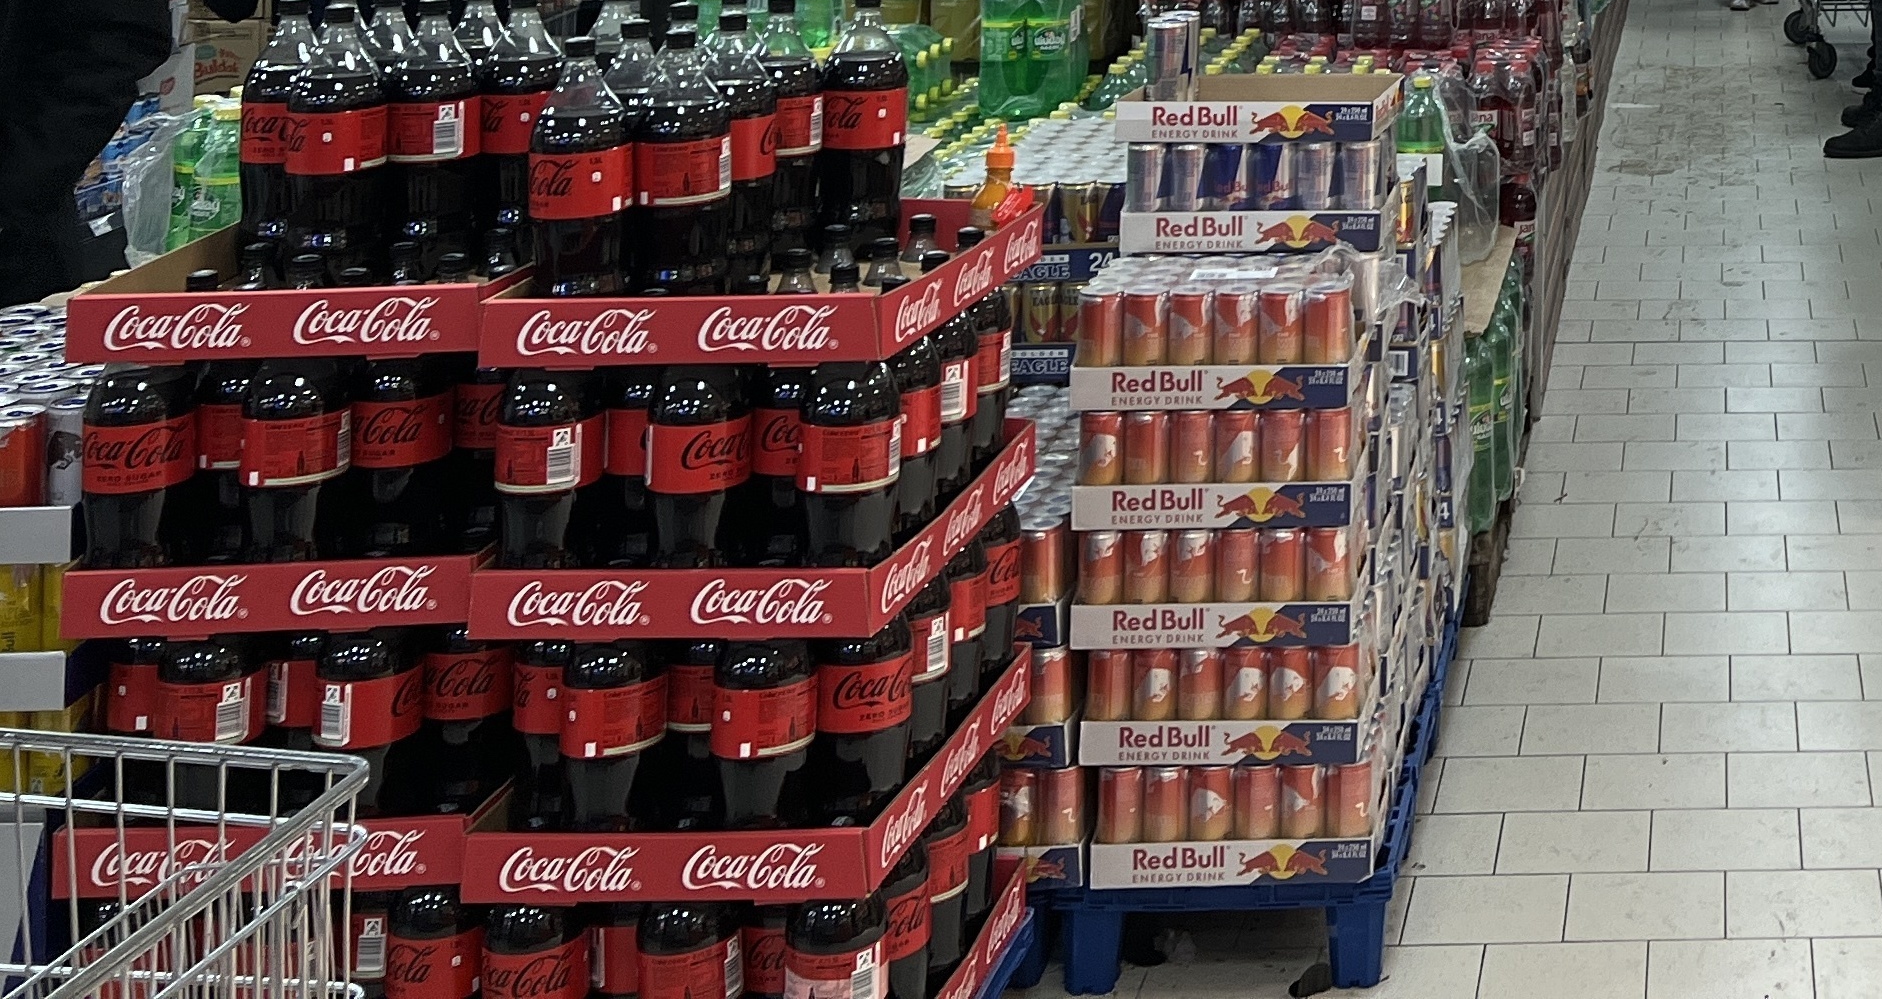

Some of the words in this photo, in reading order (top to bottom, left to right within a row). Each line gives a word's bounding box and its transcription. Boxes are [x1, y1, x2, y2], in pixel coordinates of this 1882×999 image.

[1152, 106, 1193, 126] Red
[1198, 106, 1238, 126] Bull
[1152, 130, 1199, 138] ENERGY
[1202, 130, 1238, 138] DRINK
[1003, 218, 1039, 274] Coca-Cola
[1156, 216, 1197, 237] Red
[1202, 216, 1243, 237] Bull
[1156, 241, 1203, 250] ENERGY
[1207, 241, 1243, 249] DRINK
[954, 245, 994, 307] Coca-Cola
[104, 302, 251, 351] Coca-Cola
[293, 297, 440, 345] Coca-Cola
[517, 309, 657, 355] Coca-Cola
[698, 305, 838, 351] Coca-Cola
[894, 279, 943, 343] Coca-Cola
[1111, 397, 1160, 406] ENERGY
[1165, 396, 1202, 405] DRINK
[1112, 371, 1155, 392] Red
[1160, 371, 1202, 392] Bull
[993, 437, 1030, 506] Coca-Cola
[943, 487, 984, 557] Coca-Cola
[1111, 515, 1161, 524] ENERGY
[1165, 514, 1203, 523] DRINK
[1112, 490, 1156, 511] Red
[1160, 489, 1203, 510] Bull
[290, 565, 437, 616] Coca-Cola
[881, 535, 933, 614] Coca-Cola
[100, 575, 247, 625] Coca-Cola
[507, 580, 650, 627] Coca-Cola
[690, 578, 833, 625] Coca-Cola
[1113, 610, 1157, 631] Red
[1162, 608, 1204, 630] Bull
[1113, 635, 1161, 644] ENERGY
[1166, 634, 1203, 643] DRINK
[991, 657, 1028, 735] Coca-Cola
[940, 717, 981, 798] Coca-Cola
[1119, 727, 1163, 748] Red
[1168, 725, 1210, 747] Bull
[1119, 752, 1168, 761] ENERGY
[1172, 751, 1209, 760] DRINK
[881, 781, 929, 869] Coca-Cola
[499, 846, 641, 893] Coca-Cola
[682, 843, 825, 890] Coca-Cola
[1133, 848, 1178, 870] Red
[1181, 847, 1225, 868] Bull
[1133, 873, 1182, 883] ENERGY
[1186, 872, 1224, 881] DRINK
[986, 885, 1021, 964] Coca-Cola
